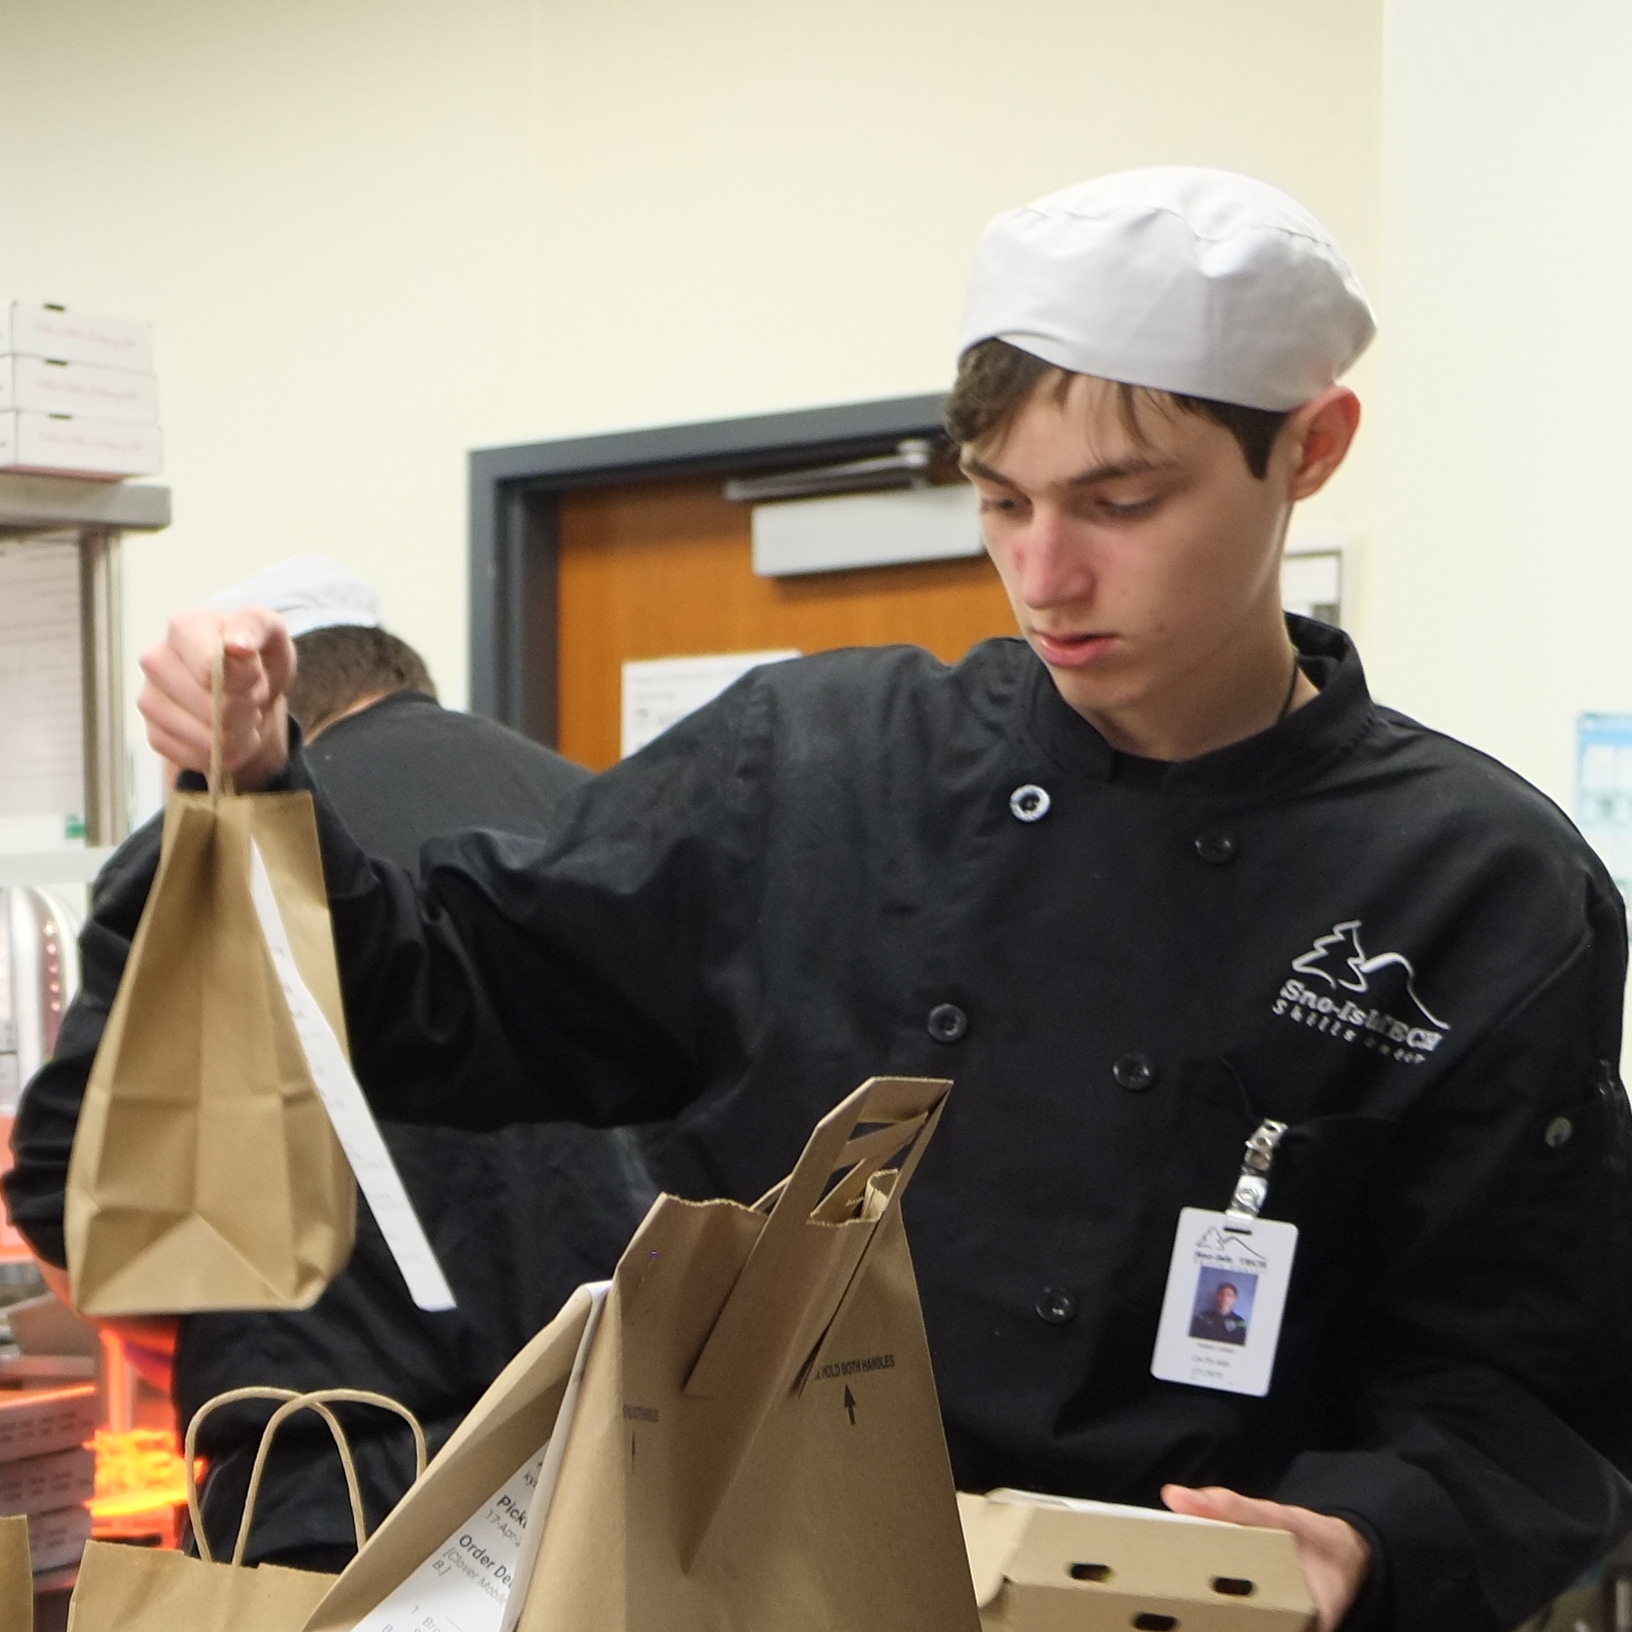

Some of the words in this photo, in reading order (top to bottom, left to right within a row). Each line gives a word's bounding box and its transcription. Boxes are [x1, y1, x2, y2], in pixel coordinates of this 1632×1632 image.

[1272, 998, 1356, 1042] Skills
[840, 1360, 861, 1376] BOTH
[861, 1354, 895, 1373] HANDLES
[459, 1534, 495, 1570] Order
